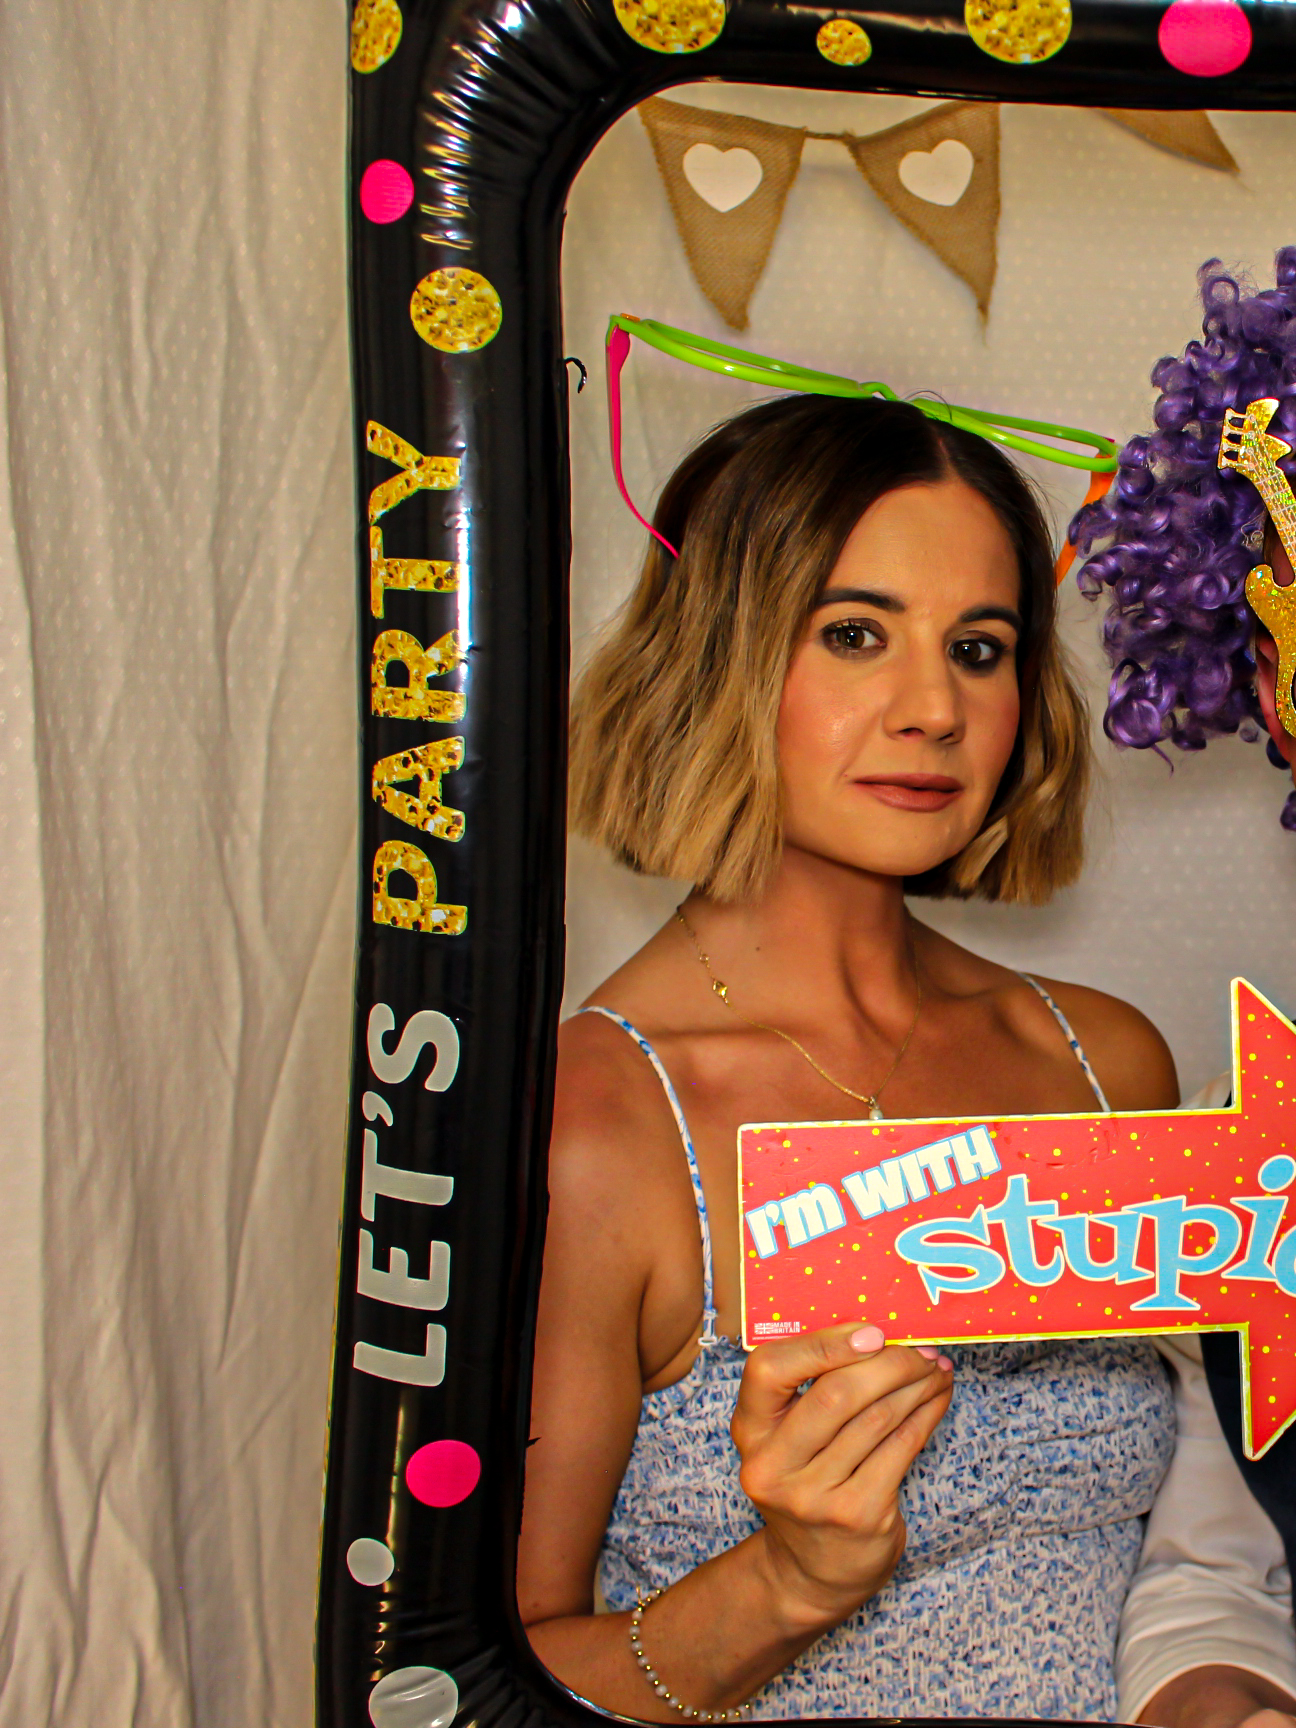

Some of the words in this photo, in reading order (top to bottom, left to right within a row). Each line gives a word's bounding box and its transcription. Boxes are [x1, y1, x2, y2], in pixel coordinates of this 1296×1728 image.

[366, 420, 468, 936] PARTY
[353, 1002, 460, 1387] LET'S
[841, 1124, 1002, 1220] WITH
